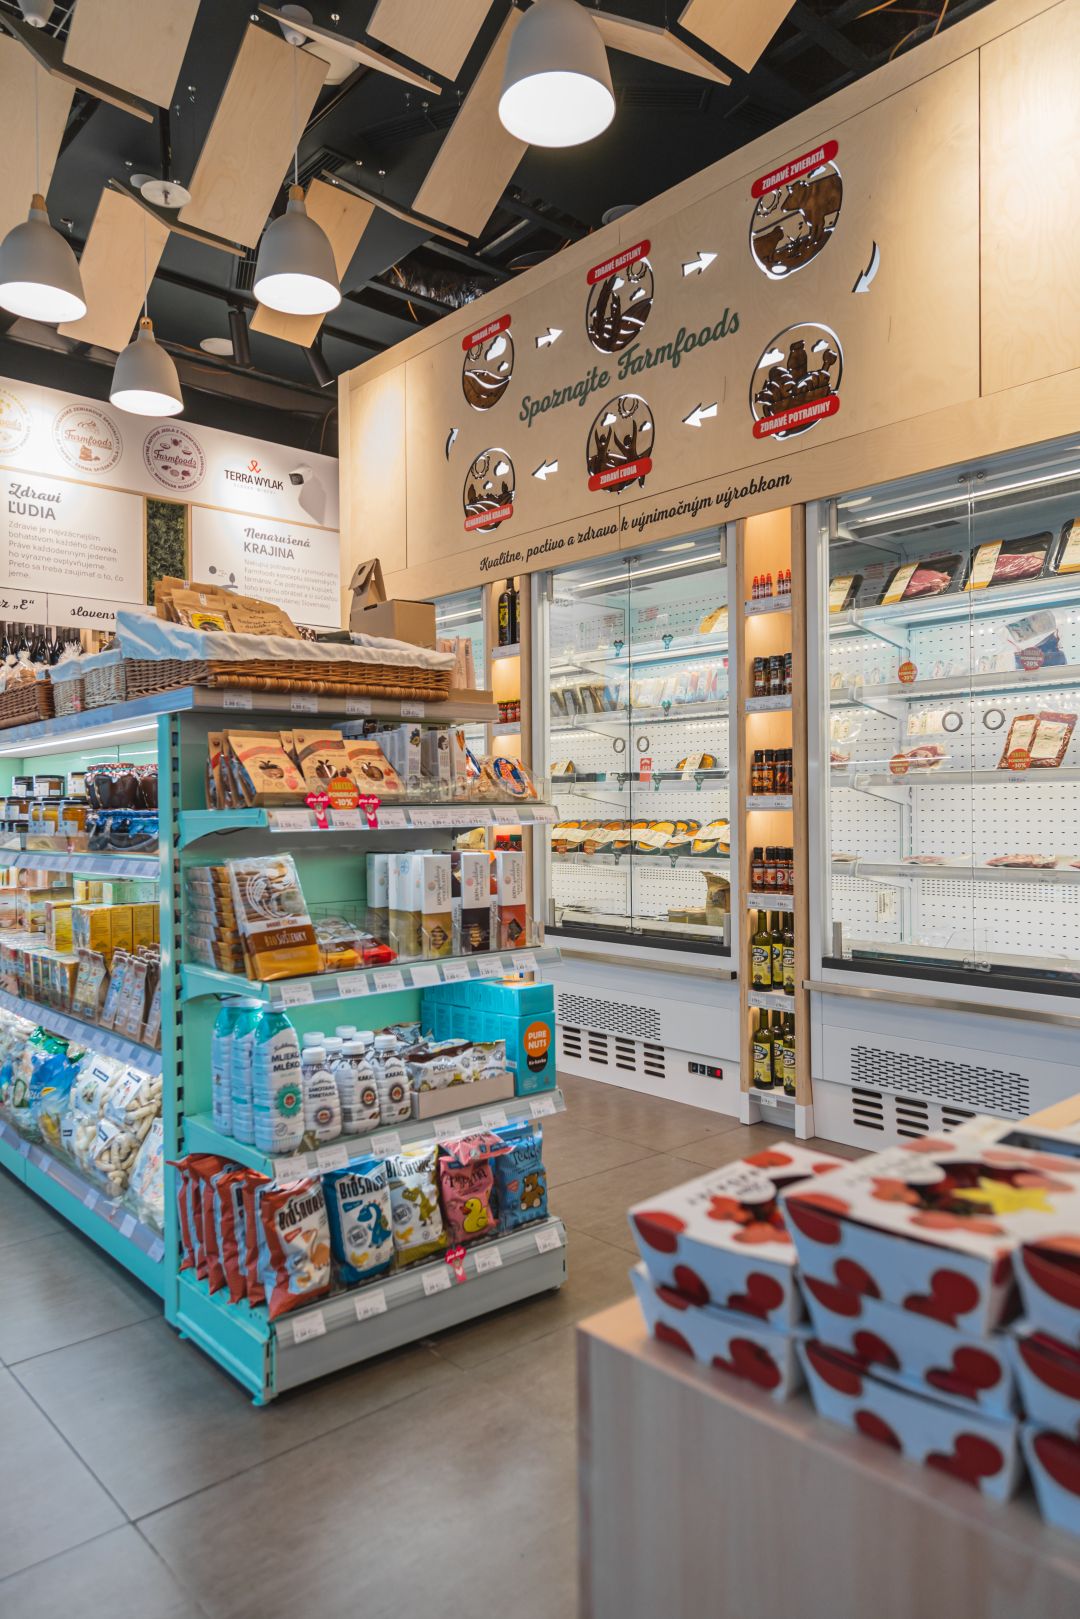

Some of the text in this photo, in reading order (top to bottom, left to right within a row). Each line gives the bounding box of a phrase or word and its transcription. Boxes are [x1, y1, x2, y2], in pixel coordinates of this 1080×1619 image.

[762, 147, 825, 190] ZDRAVÉ ZVIERATÁ
[519, 307, 740, 428] Spoznajte Farmfoods
[760, 400, 831, 433] ZDRAVÉ POTRAVINY
[153, 449, 197, 466] Farmfoods
[224, 470, 254, 485] TERRA
[255, 476, 284, 491] WYLAK
[8, 500, 56, 520] ĽUDIA
[480, 474, 793, 572] Kvalitne, poctivo a zdravo k výnimočným výrobkom
[243, 527, 311, 548] Nenarušená
[243, 541, 295, 560] KRAJINA
[528, 1030, 547, 1041] PURE
[528, 1039, 547, 1050] NUTS
[273, 1061, 300, 1072] MLÉKO
